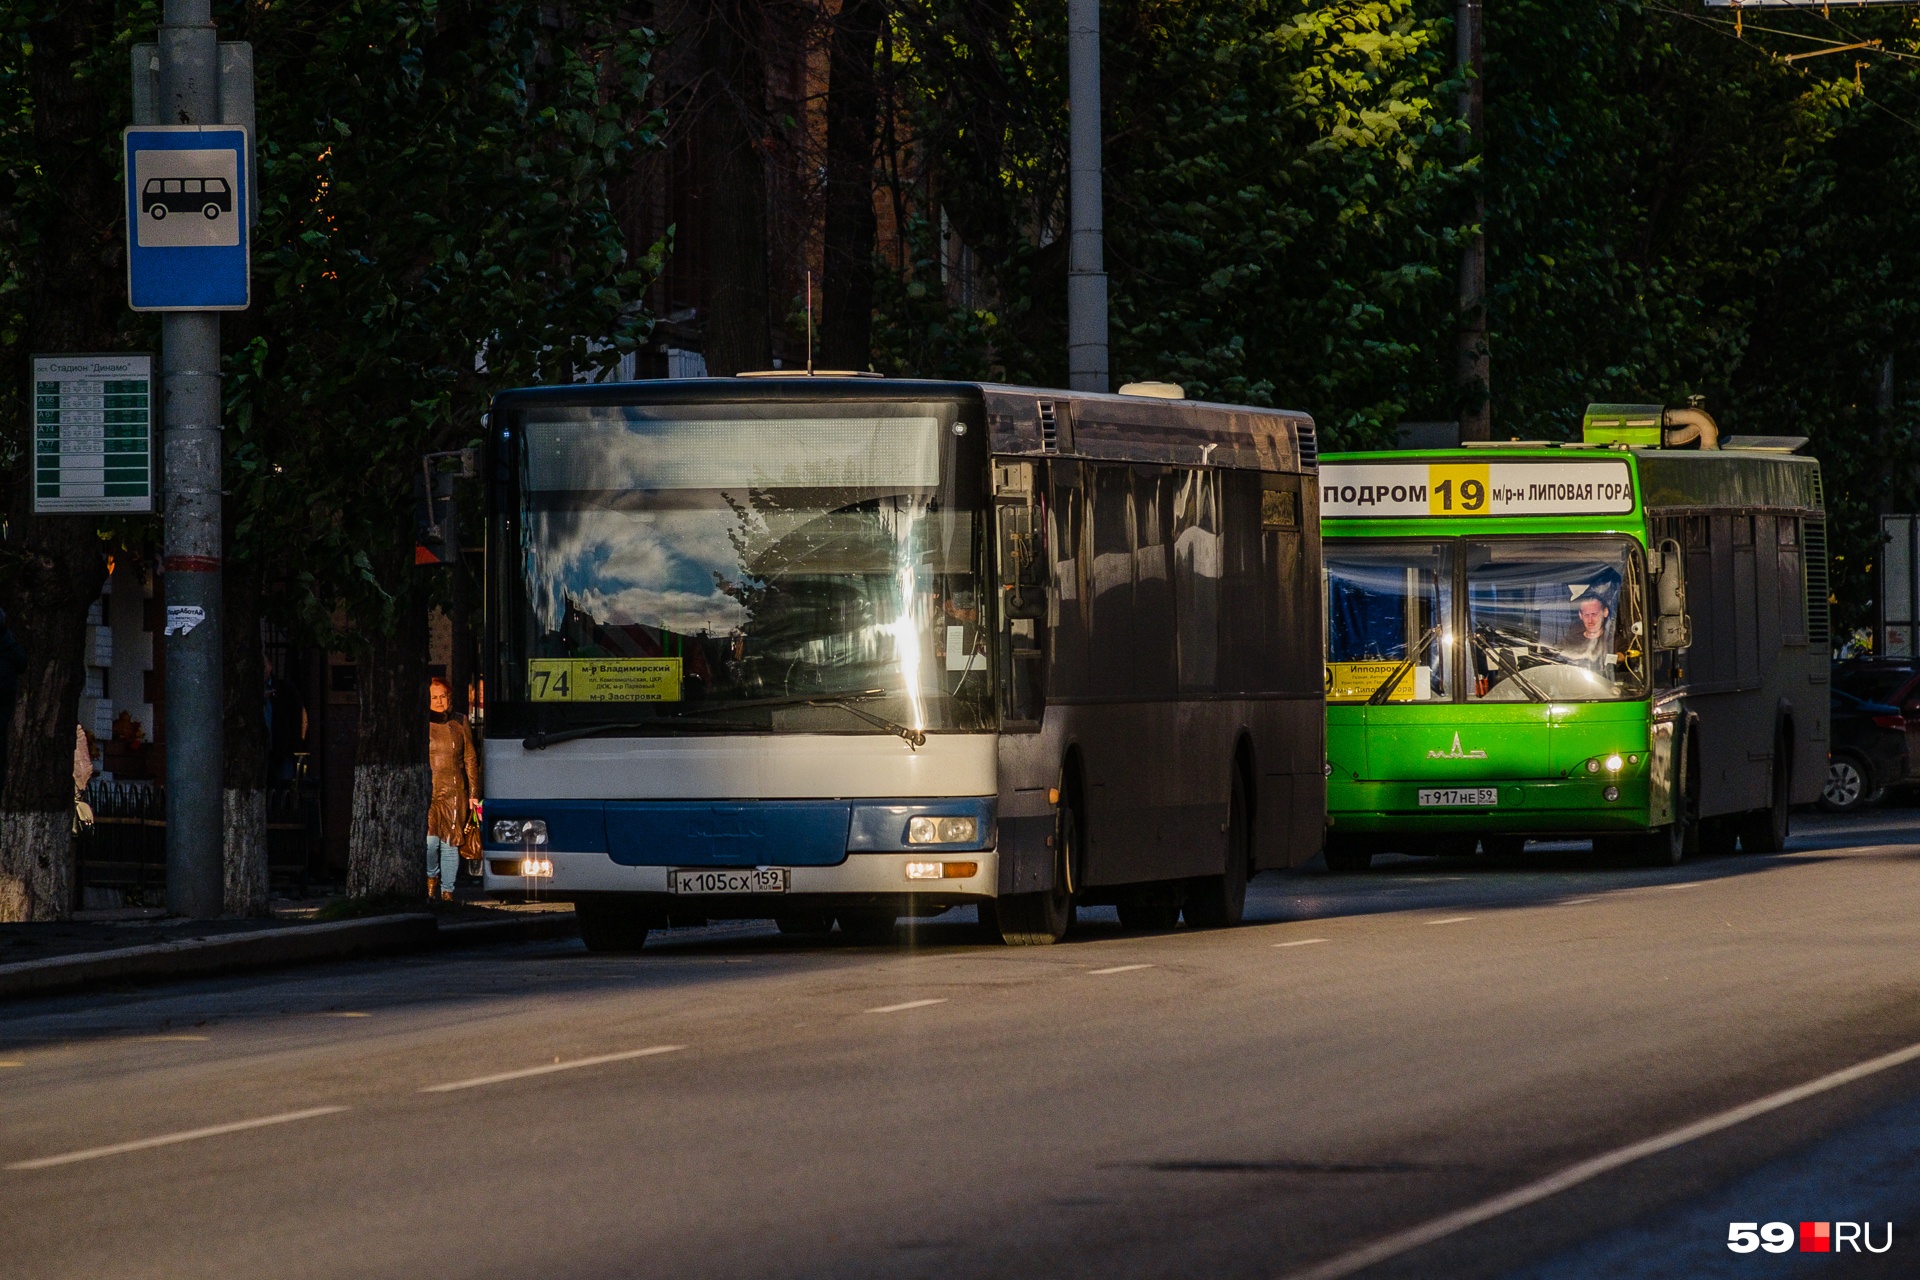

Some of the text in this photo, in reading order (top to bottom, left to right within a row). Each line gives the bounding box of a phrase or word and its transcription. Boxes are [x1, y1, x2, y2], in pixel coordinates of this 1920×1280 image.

[50, 364, 88, 373] Стадион
[90, 362, 132, 373] "Динамо"
[1319, 479, 1632, 511] ПОДРОМ 19 м/р-н ЛИПОВАЯ ГОРА
[582, 664, 670, 675] м-р Владимирский
[532, 669, 570, 698] 74
[1397, 686, 1413, 694] ора
[590, 692, 662, 701] м-р Заостровка
[1479, 789, 1493, 800] 59
[683, 871, 780, 892] К105СХ 159
